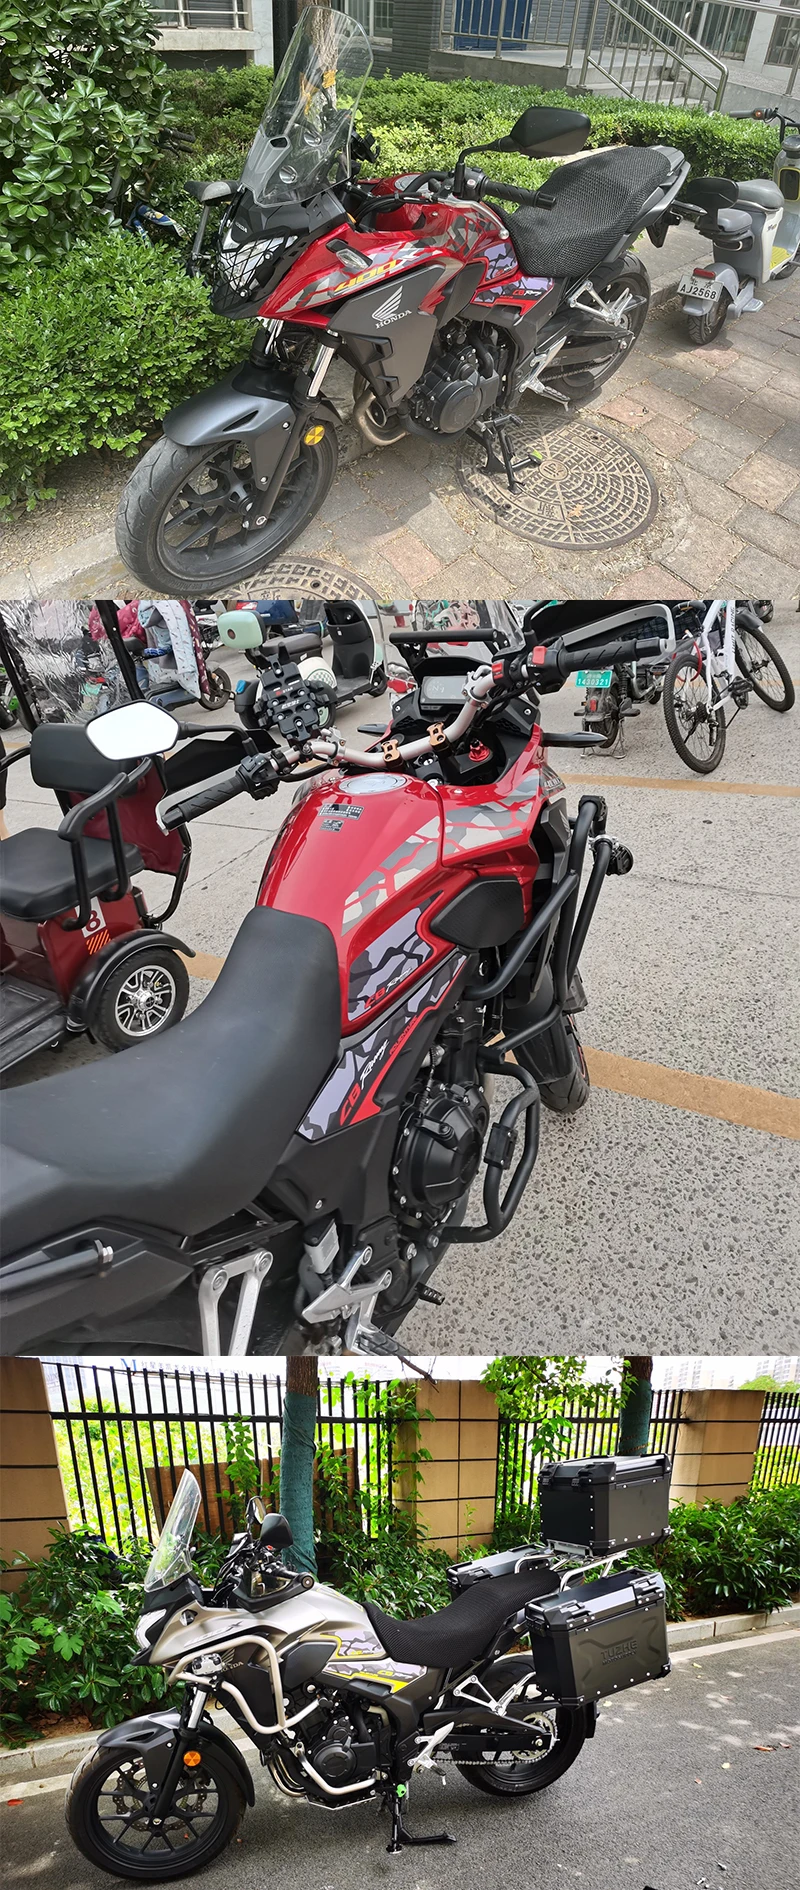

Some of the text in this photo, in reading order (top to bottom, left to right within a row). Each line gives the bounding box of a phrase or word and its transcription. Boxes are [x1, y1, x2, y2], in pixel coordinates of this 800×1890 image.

[680, 284, 717, 300] AJ2568
[375, 309, 412, 329] HONDA
[339, 1083, 361, 1126] CB
[600, 1640, 638, 1660] TUZHE
